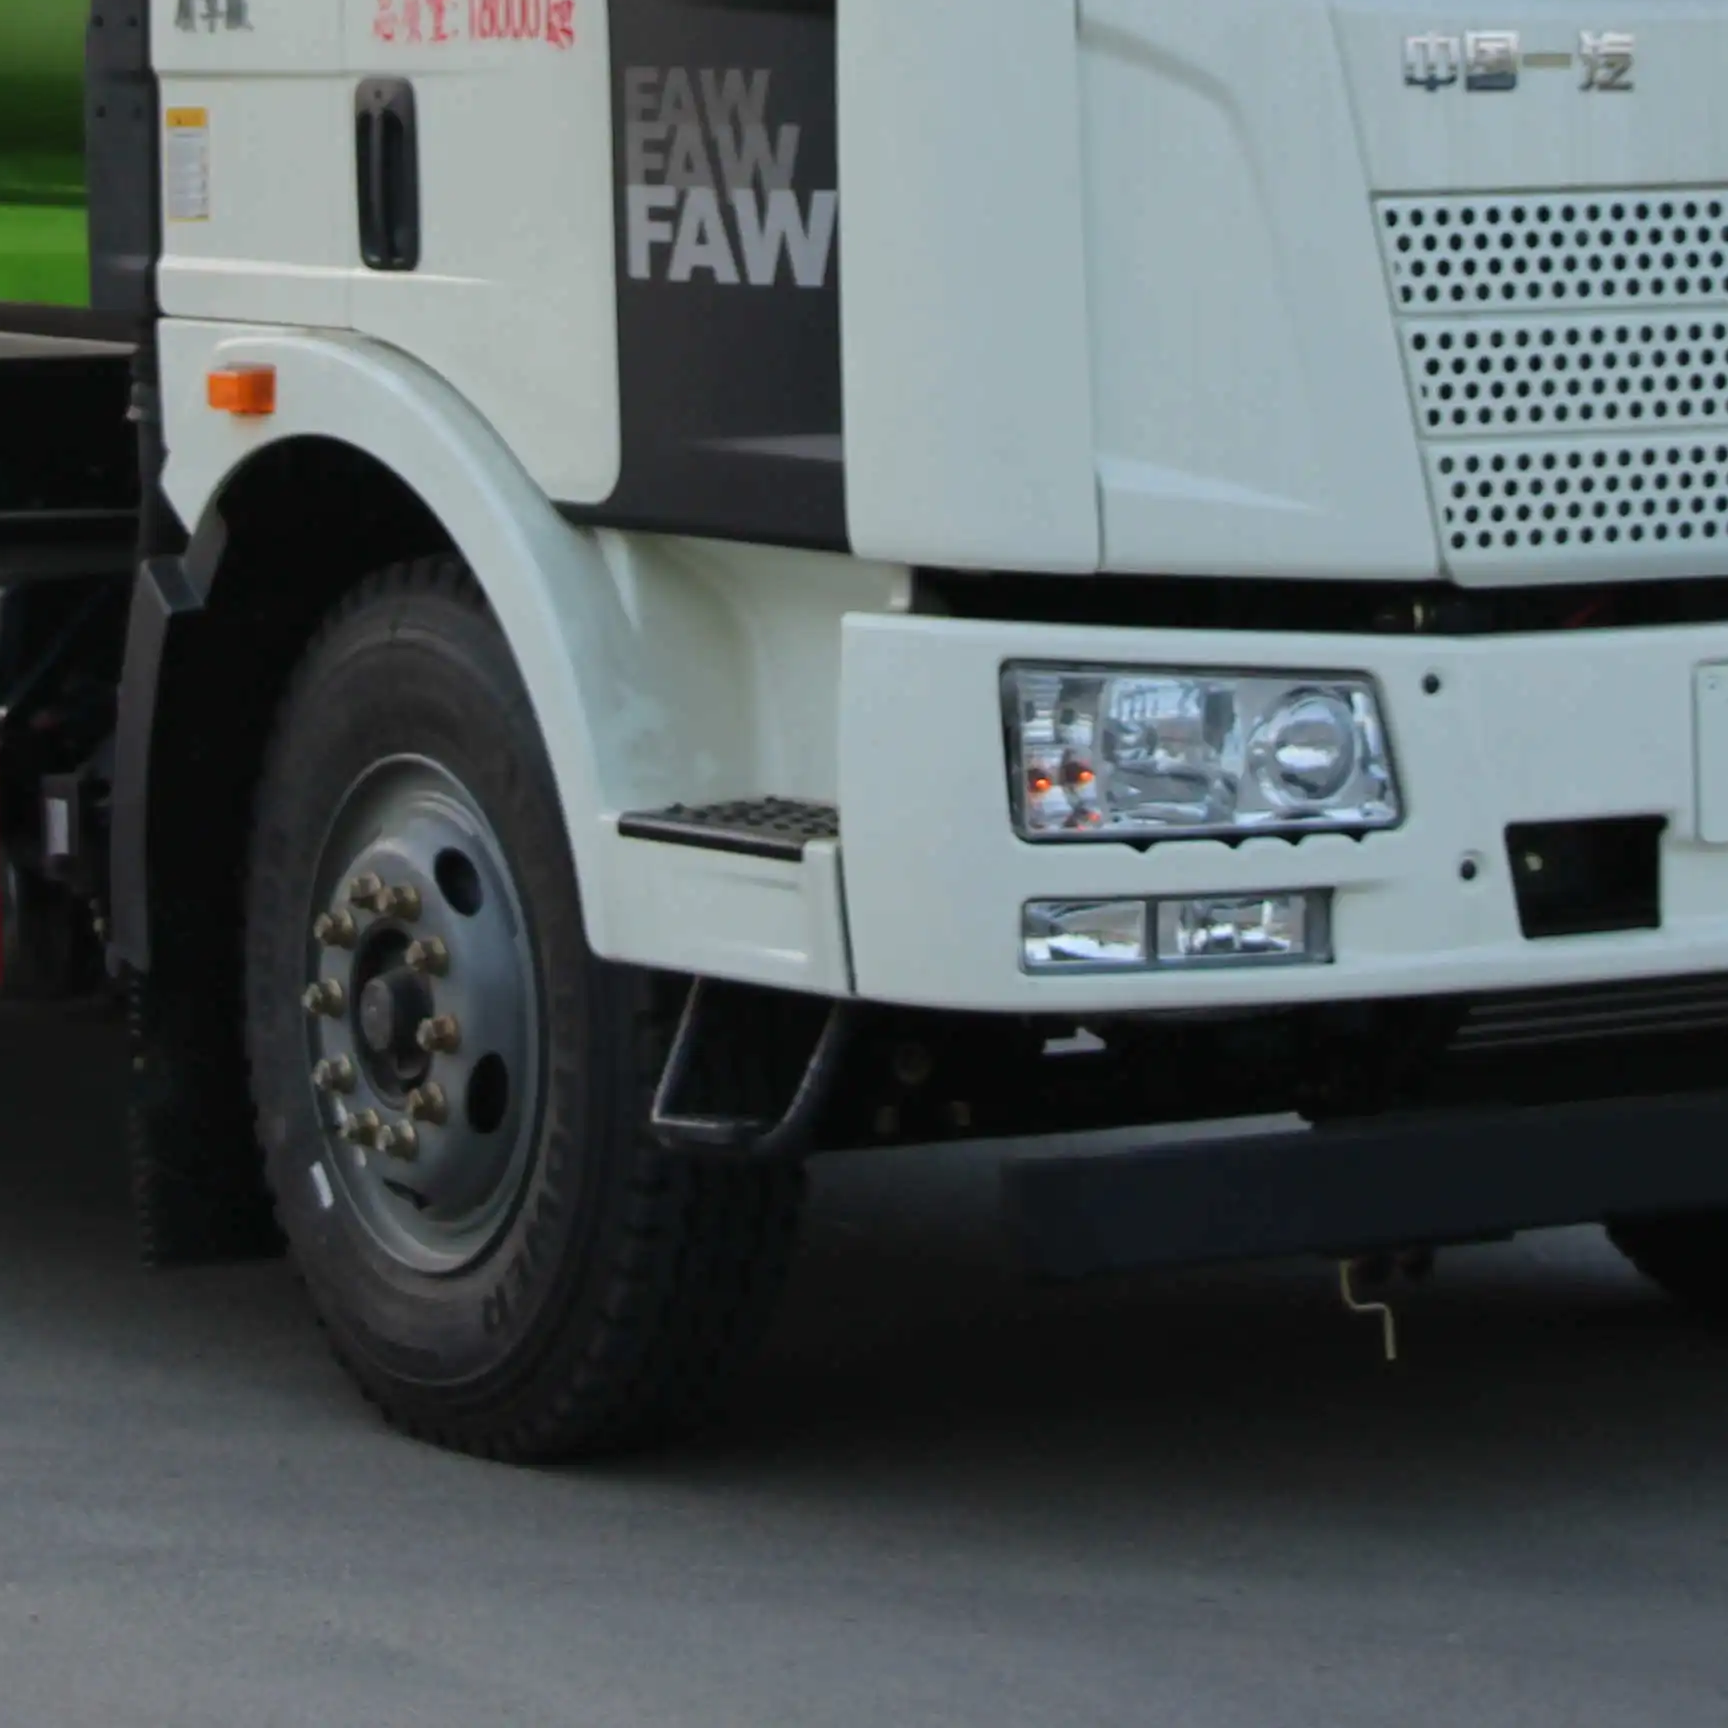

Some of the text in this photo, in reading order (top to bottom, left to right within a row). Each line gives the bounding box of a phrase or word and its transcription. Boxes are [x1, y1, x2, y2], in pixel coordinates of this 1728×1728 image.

[1403, 29, 1635, 92] 中国一汽
[627, 184, 838, 288] FAW
